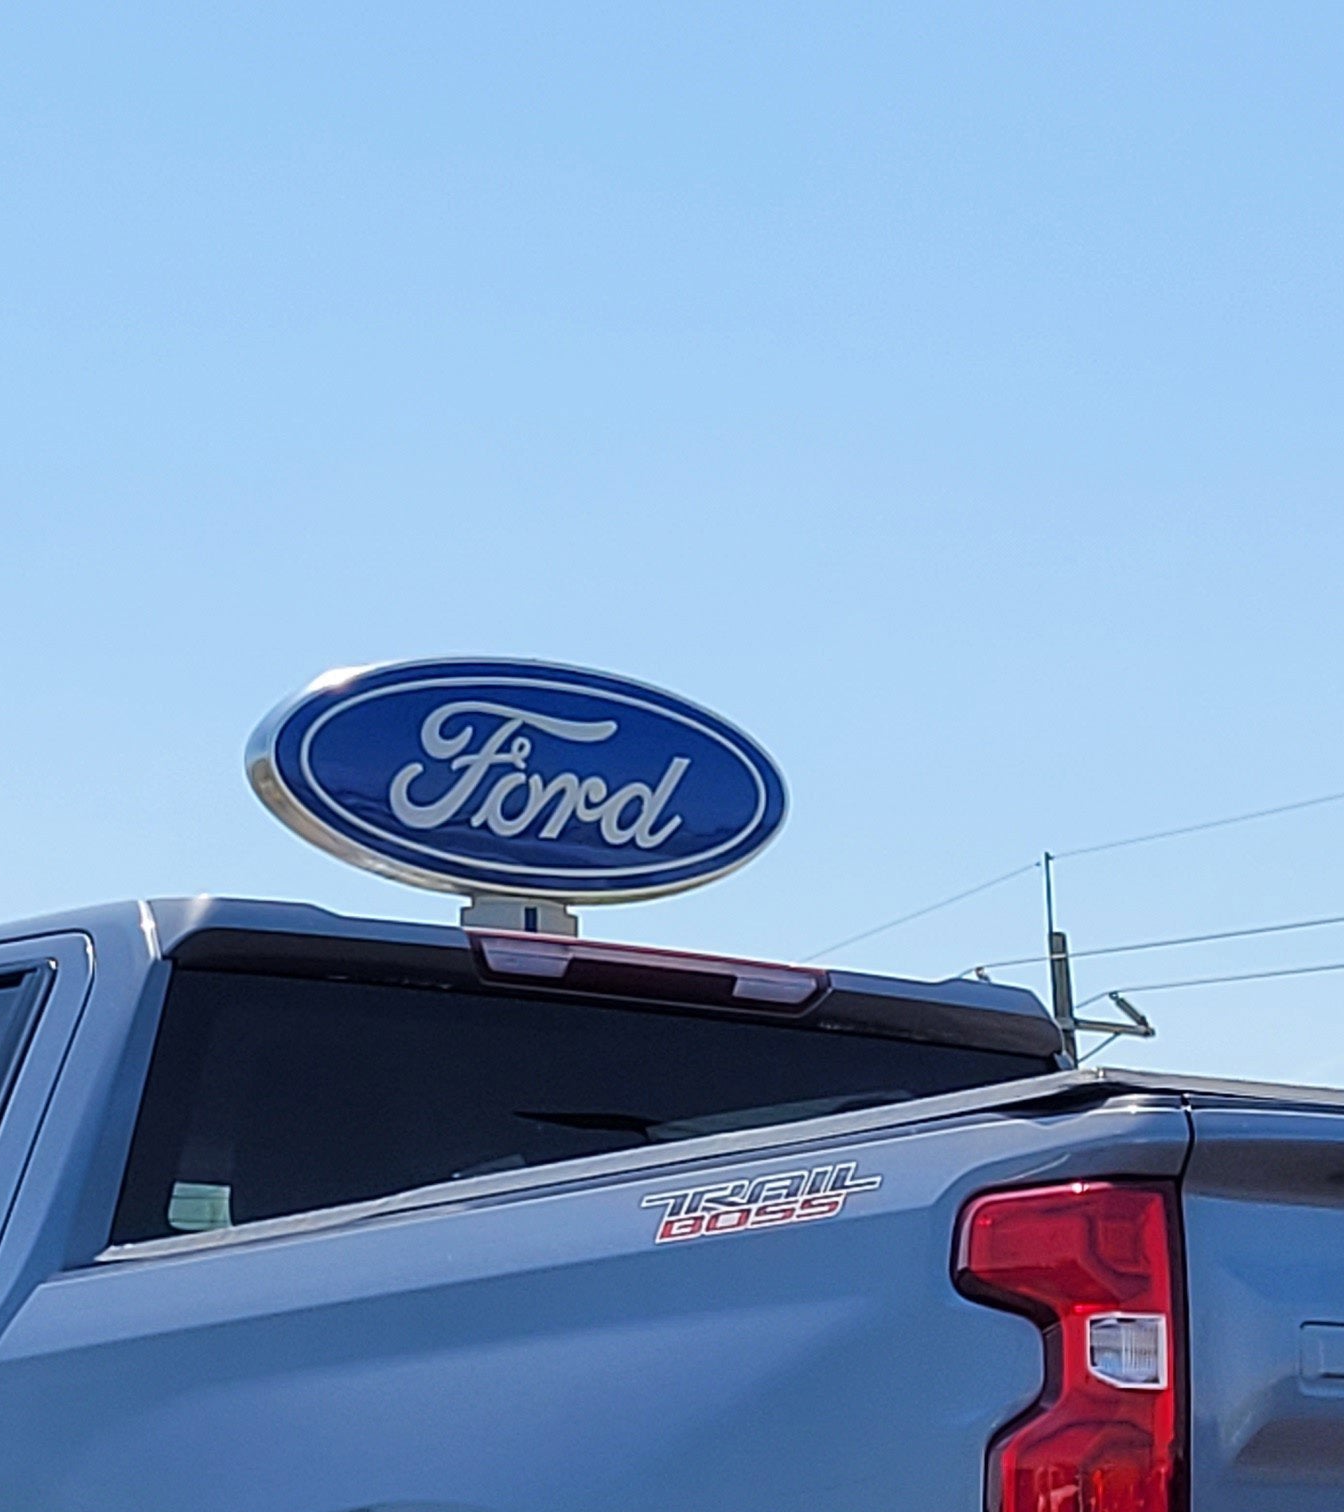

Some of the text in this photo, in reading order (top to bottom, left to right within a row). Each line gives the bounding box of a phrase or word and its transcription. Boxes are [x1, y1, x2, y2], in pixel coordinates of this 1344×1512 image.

[389, 701, 692, 849] Ford
[640, 1161, 882, 1217] TRAIL
[655, 1191, 846, 1244] BOSS
